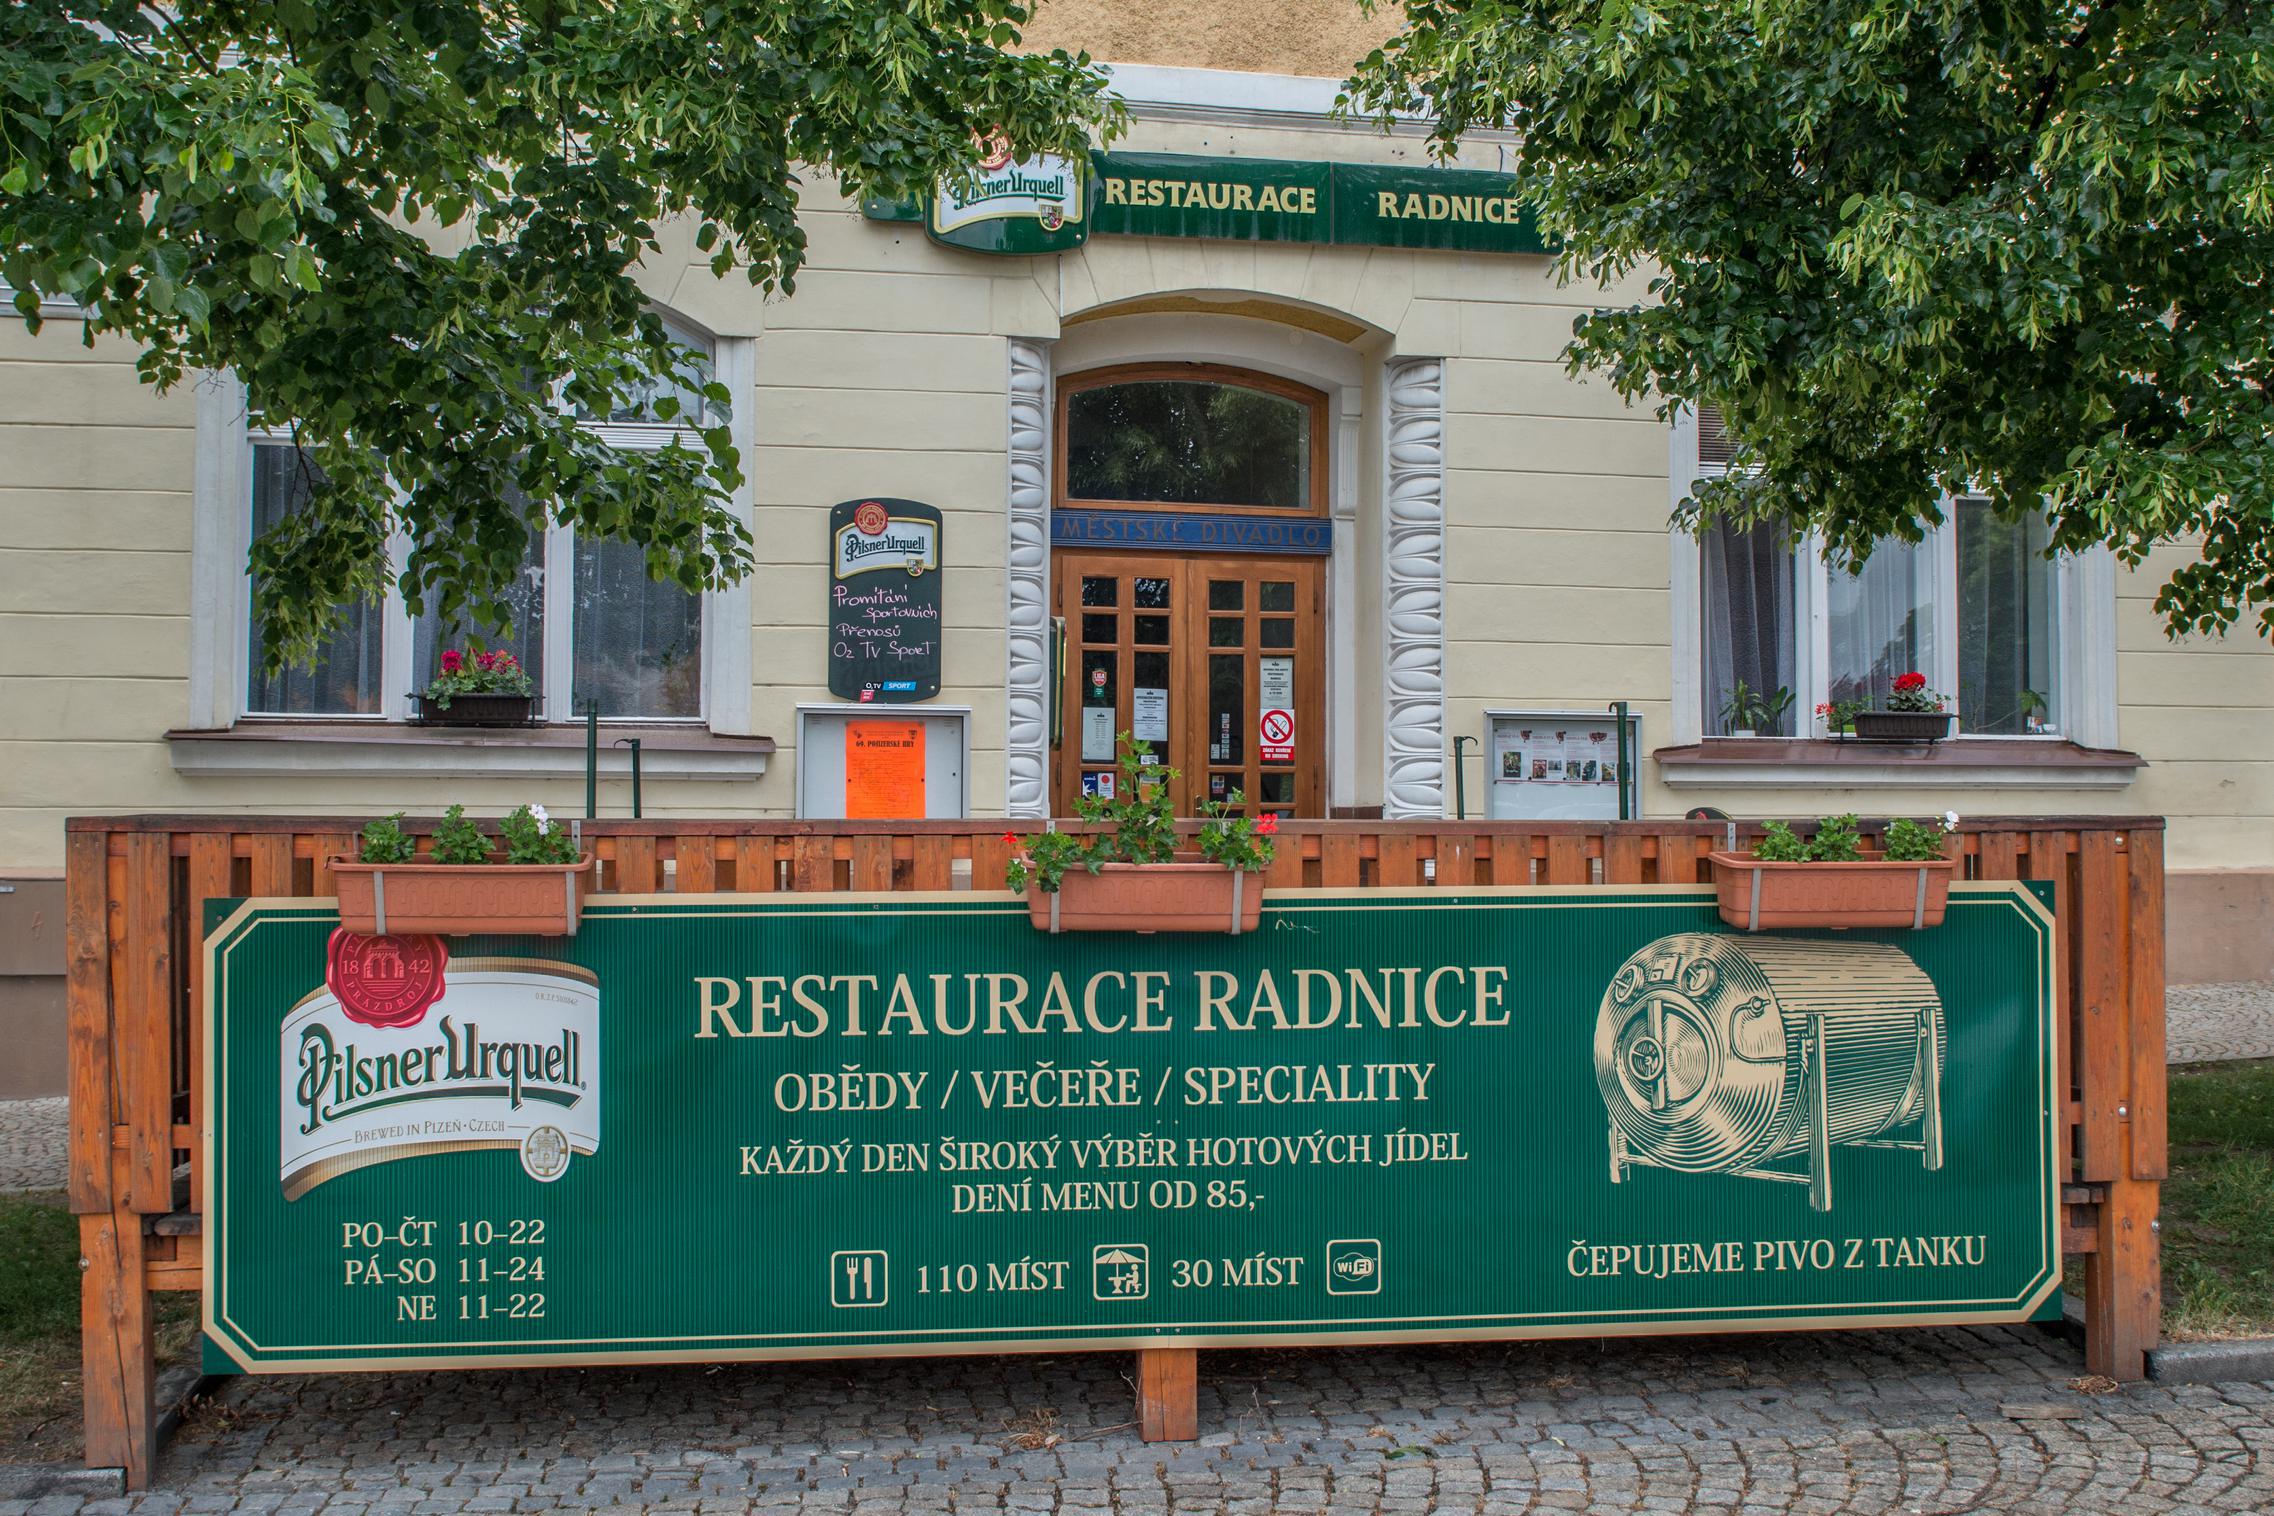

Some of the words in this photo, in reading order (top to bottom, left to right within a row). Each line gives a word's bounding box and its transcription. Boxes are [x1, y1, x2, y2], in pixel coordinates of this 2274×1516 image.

[1009, 168, 1064, 202] Urquell
[1104, 176, 1317, 215] RESTAURACE
[1377, 191, 1520, 226] RADNICE
[844, 533, 887, 563] Pilsner
[886, 533, 925, 556] Urquell
[1061, 512, 1185, 543] MĚSTSKÉ
[1201, 522, 1322, 548] DIVADLO
[342, 960, 360, 975] 18
[408, 959, 431, 974] 42
[345, 980, 424, 1012] PRAZDROJ
[693, 970, 1174, 1039] RESTAURACE
[1193, 965, 1512, 1032] RADNICE
[297, 1022, 445, 1136] Pilsner
[439, 1014, 582, 1112] Urquell
[774, 1063, 929, 1112] OBĚDY
[971, 1059, 1142, 1109] VEČEŘE
[1183, 1063, 1436, 1106] SPECIALITY
[354, 1125, 404, 1144] BREWED
[406, 1123, 421, 1136] IN
[739, 1137, 854, 1175] KAŽDÝ
[861, 1143, 931, 1173] DEN
[939, 1134, 1063, 1172] ŠIROKÝ
[1070, 1131, 1178, 1169] VÝBĚR
[1186, 1129, 1373, 1167] HOTOVÝCH
[1378, 1127, 1469, 1167] JÍDEL
[952, 1177, 1033, 1213] DENÍ
[1041, 1181, 1141, 1212] MENU
[1149, 1180, 1197, 1210] OD
[1206, 1179, 1265, 1212] 85,-
[342, 1216, 438, 1248] PO-ČT
[458, 1219, 546, 1247] 10-22
[343, 1254, 438, 1285] PÁ-SO
[458, 1256, 546, 1283] 11-24
[917, 1263, 978, 1294] 110
[986, 1256, 1070, 1292] MÍST
[1171, 1259, 1214, 1288] 30
[1222, 1251, 1304, 1287] MÍST
[1566, 1239, 1745, 1278] ČEPUJEME
[1753, 1239, 1835, 1271] PIVO
[1843, 1238, 1864, 1269] Z
[1871, 1235, 1987, 1269] TANKU
[397, 1295, 438, 1321] NE
[458, 1293, 546, 1320] 11-22
